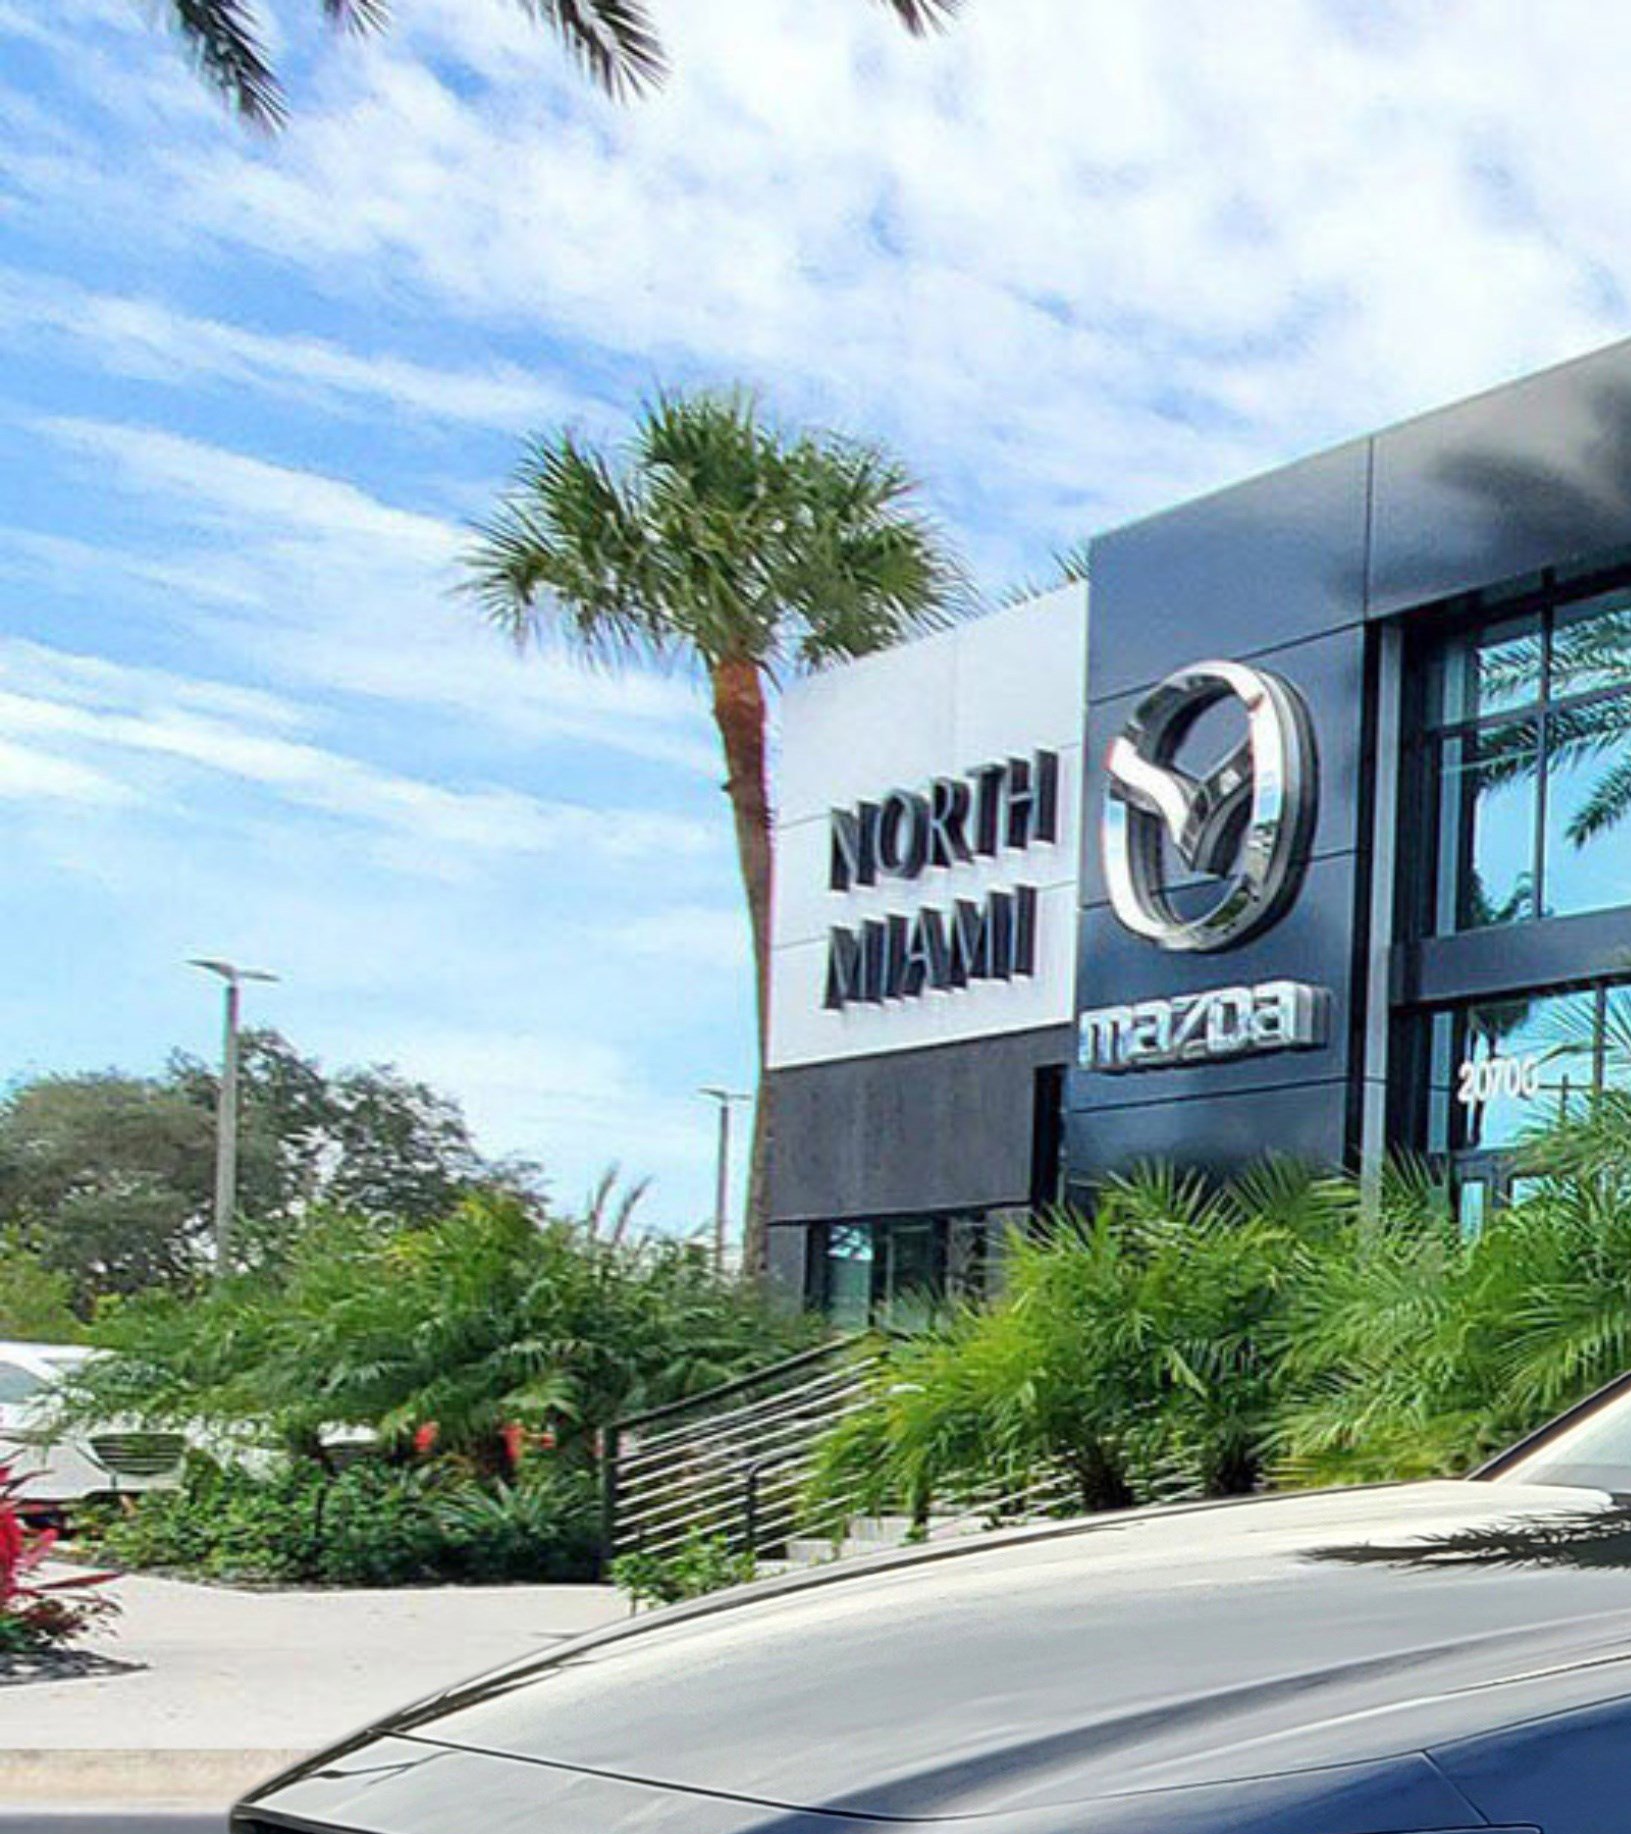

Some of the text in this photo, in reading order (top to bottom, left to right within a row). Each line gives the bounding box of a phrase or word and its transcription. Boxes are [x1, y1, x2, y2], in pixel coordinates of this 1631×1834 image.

[828, 747, 1059, 893] NORTH
[823, 883, 1036, 1010] MIAMI
[1078, 980, 1326, 1070] mazda
